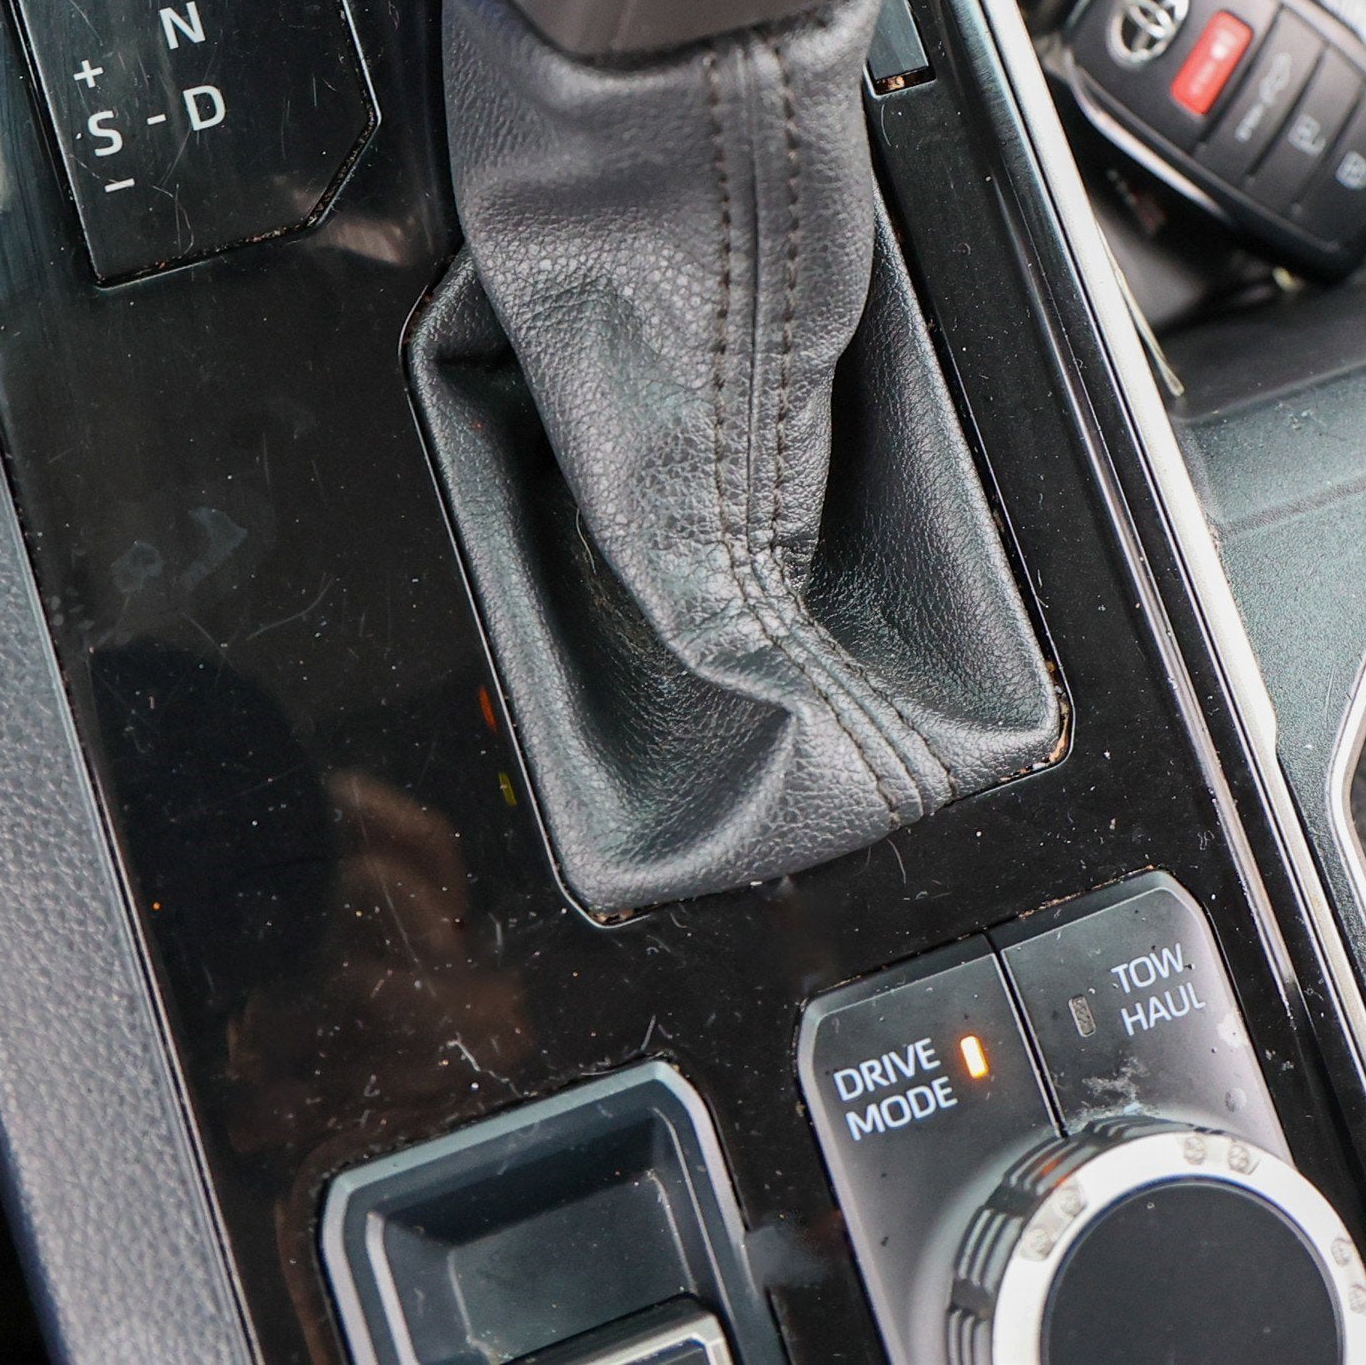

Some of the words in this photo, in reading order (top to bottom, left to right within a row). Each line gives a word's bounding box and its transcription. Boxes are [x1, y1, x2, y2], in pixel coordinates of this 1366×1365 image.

[158, 1, 206, 50] N
[86, 110, 123, 156] S
[183, 84, 227, 132] D
[1111, 943, 1186, 996] TOW
[1120, 982, 1207, 1037] HAUL
[833, 1037, 941, 1102] DRIVE
[844, 1076, 958, 1140] MODE
